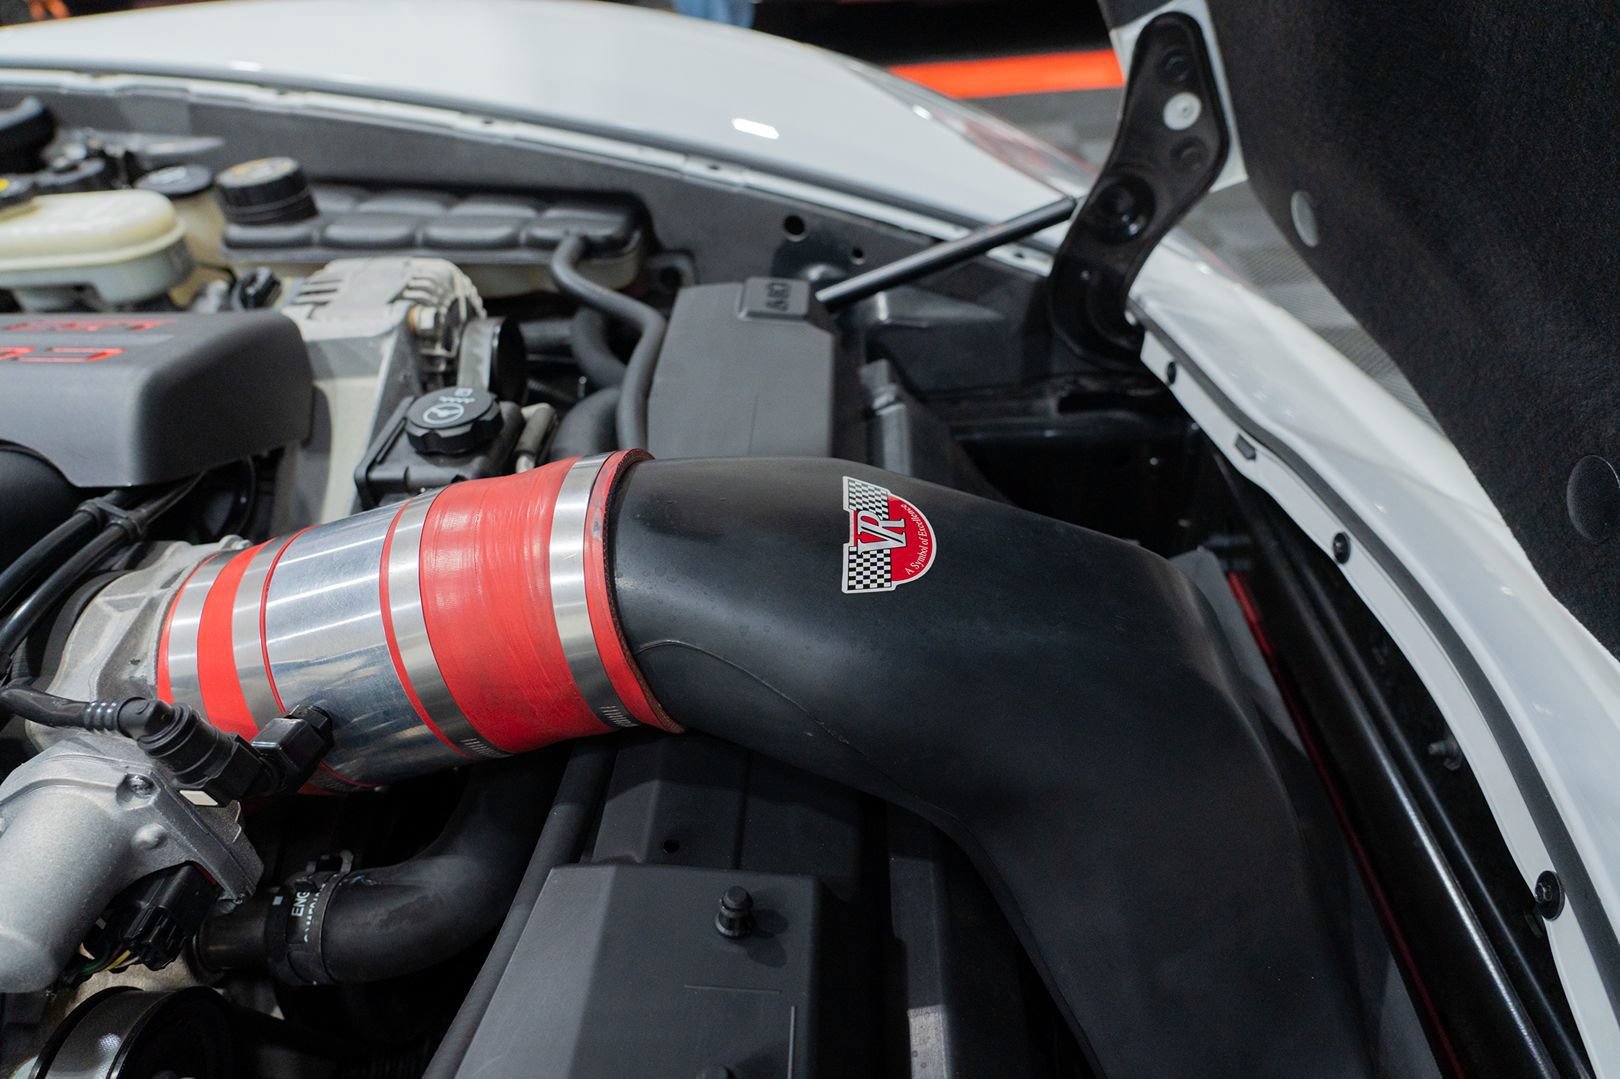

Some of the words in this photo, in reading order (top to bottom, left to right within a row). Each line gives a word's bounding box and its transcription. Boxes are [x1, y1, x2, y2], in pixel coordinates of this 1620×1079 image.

[857, 510, 907, 555] VR
[900, 503, 928, 537] Excellence
[919, 536, 929, 545] of
[910, 545, 928, 569] Symbol
